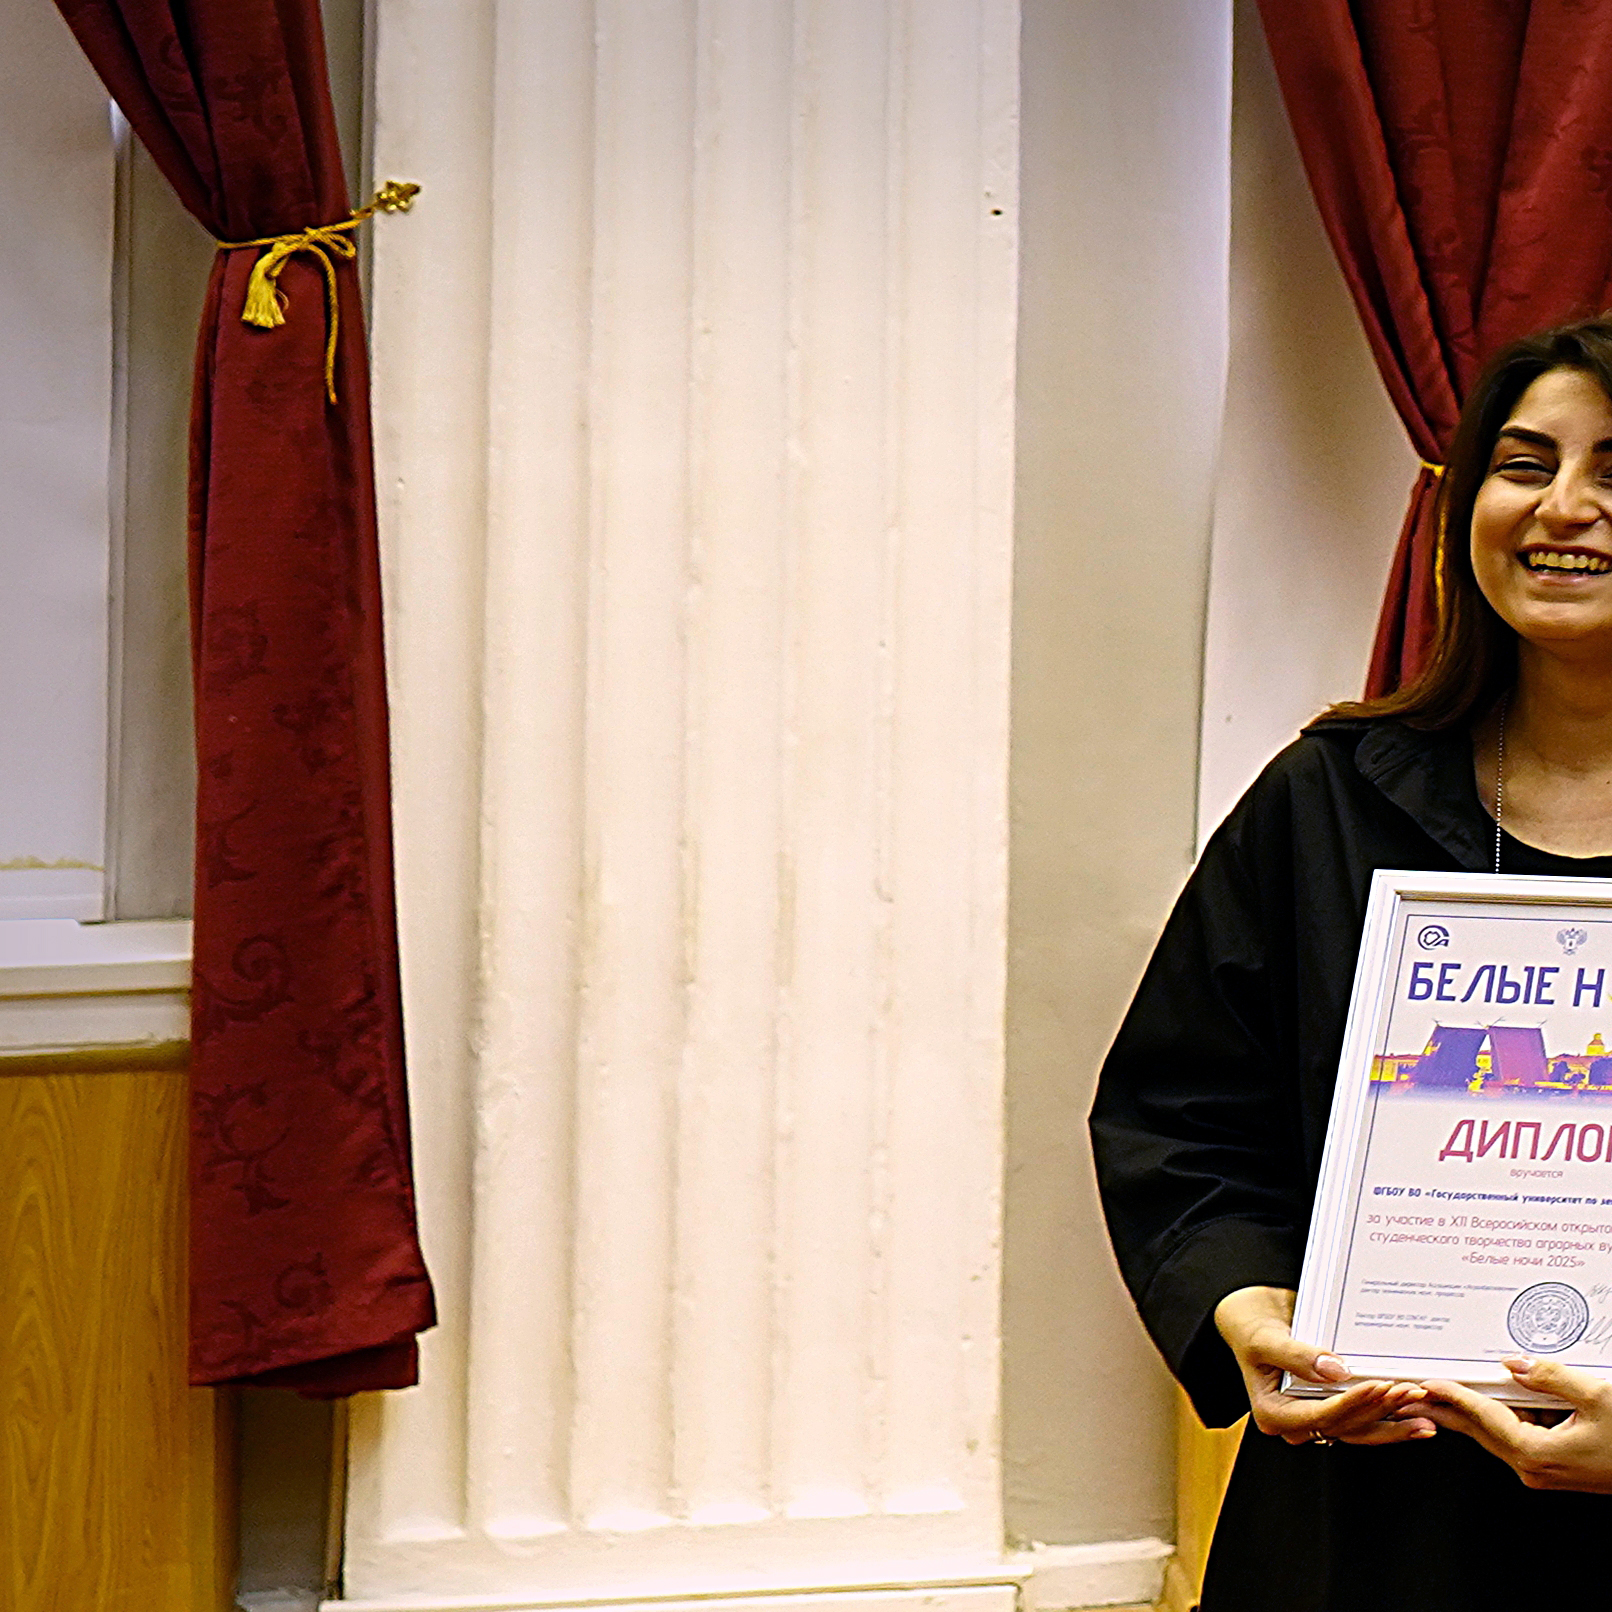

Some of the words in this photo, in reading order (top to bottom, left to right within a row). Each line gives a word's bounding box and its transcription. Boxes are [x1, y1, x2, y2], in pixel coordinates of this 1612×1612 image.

[1407, 962, 1560, 1005] БЕЛЫЕ
[1510, 1168, 1564, 1179] вручается
[1373, 1186, 1405, 1197] ФГБОУ
[1408, 1188, 1421, 1198] ВО
[1425, 1189, 1519, 1201] «Государственный
[1522, 1195, 1582, 1205] университет
[1585, 1197, 1597, 1205] по
[1367, 1214, 1381, 1224] за
[1386, 1215, 1434, 1227] участие
[1438, 1217, 1445, 1226] в
[1369, 1231, 1460, 1246] студенческого
[1465, 1236, 1532, 1248] творчества
[1535, 1239, 1595, 1252] аграрных
[1461, 1252, 1510, 1265] «Белые
[1513, 1255, 1543, 1266] ночи
